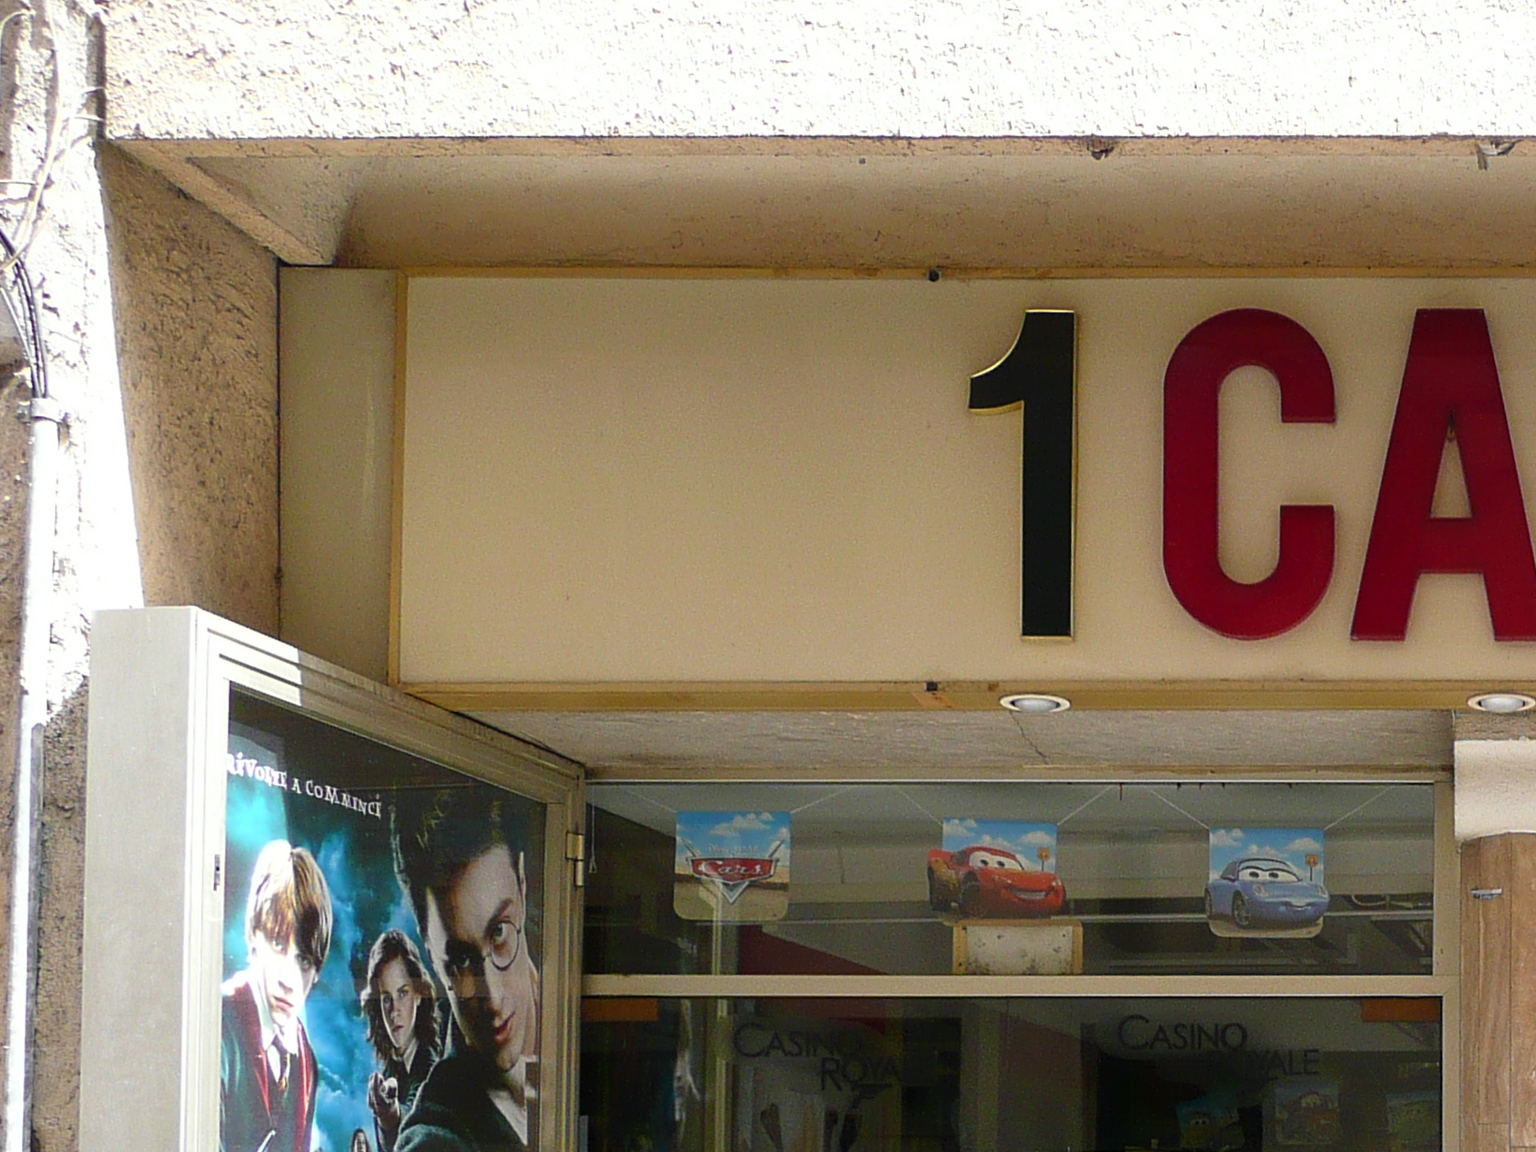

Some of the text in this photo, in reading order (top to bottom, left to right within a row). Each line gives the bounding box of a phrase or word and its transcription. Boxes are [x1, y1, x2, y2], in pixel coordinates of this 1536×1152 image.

[968, 307, 1077, 639] 1
[698, 860, 766, 881] Cars
[1117, 1013, 1249, 1050] CASINO
